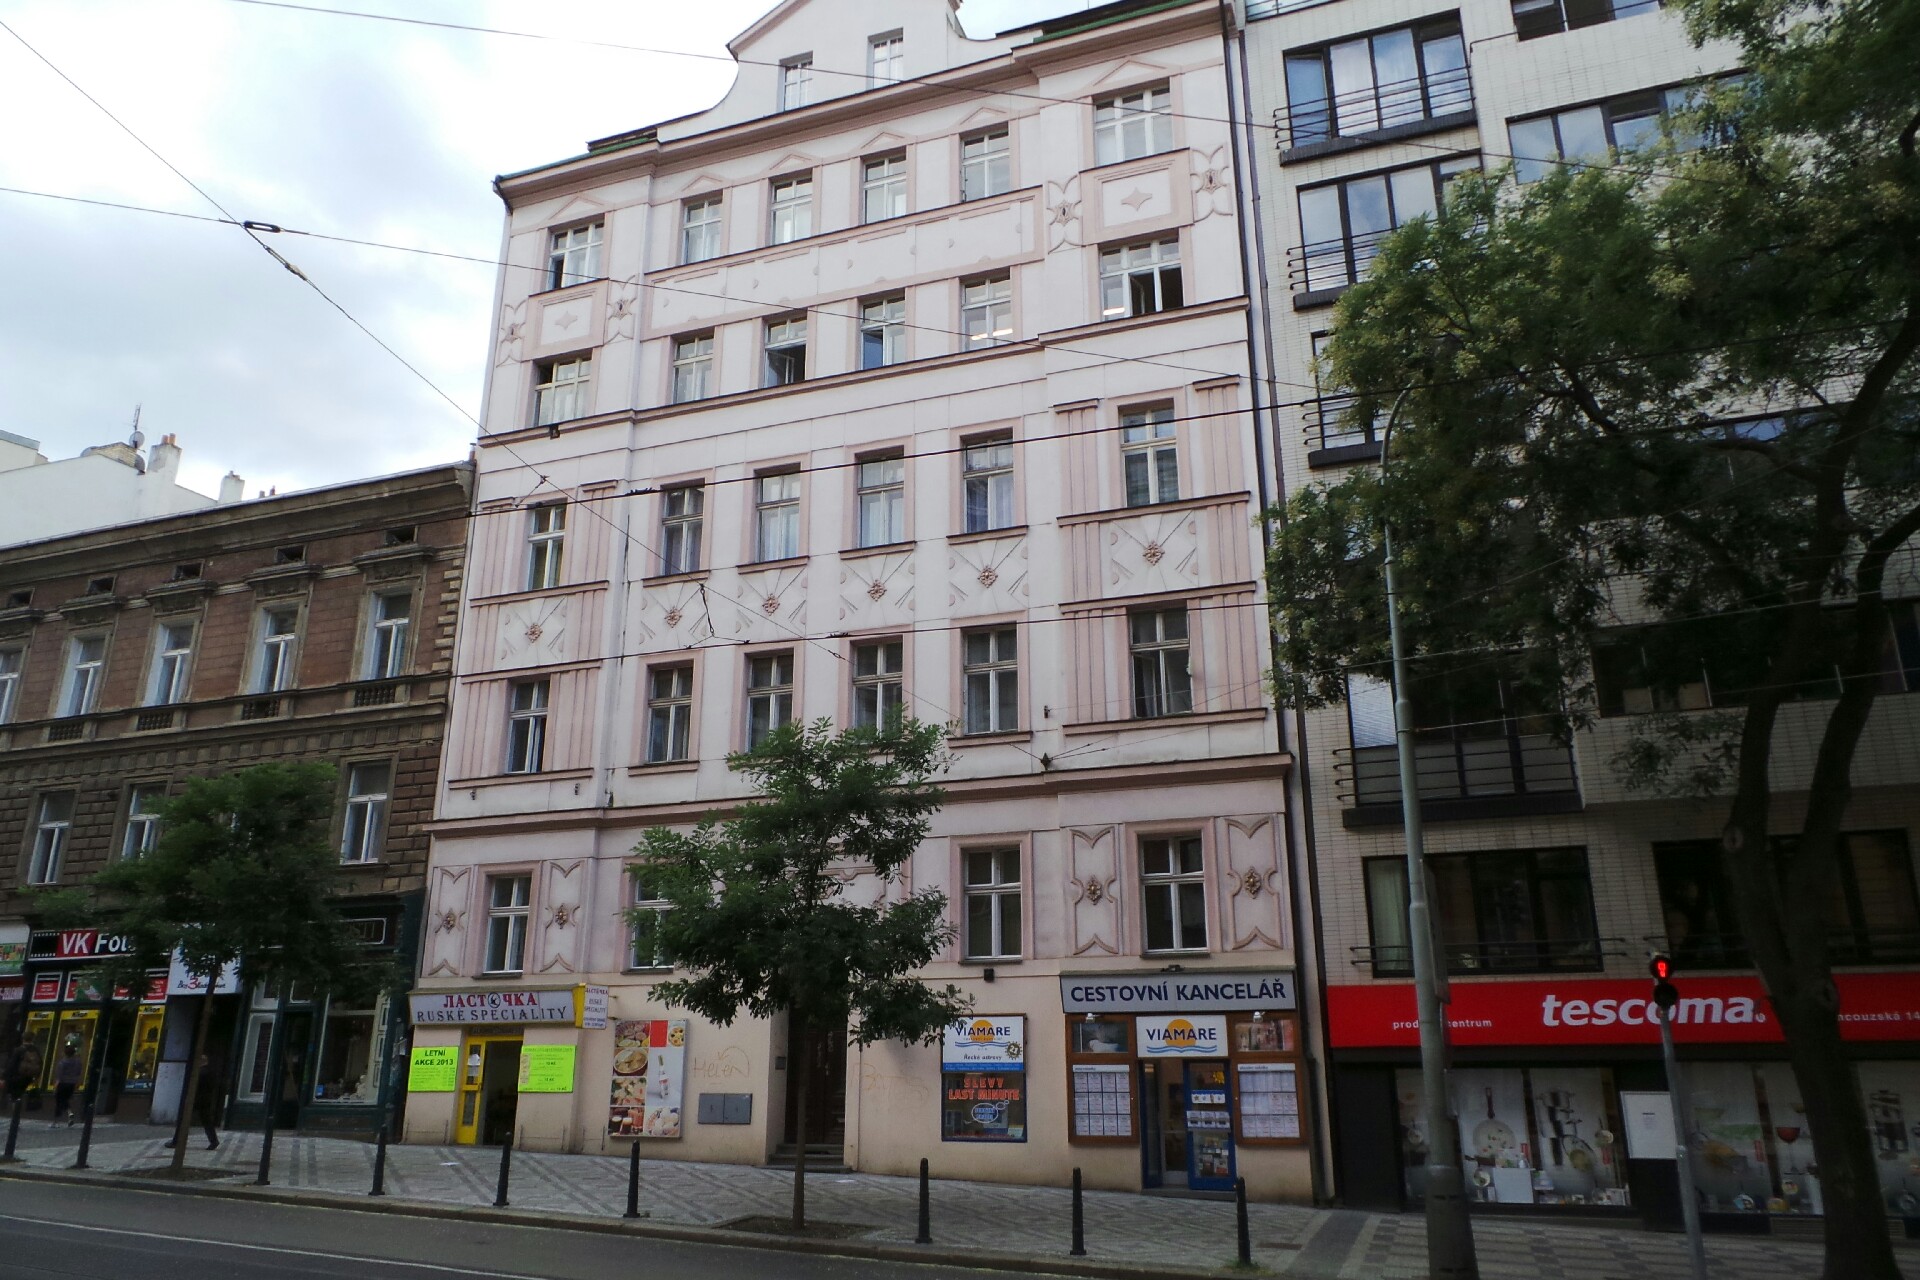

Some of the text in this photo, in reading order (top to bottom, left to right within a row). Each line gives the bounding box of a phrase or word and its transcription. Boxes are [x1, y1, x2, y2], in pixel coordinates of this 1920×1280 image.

[62, 932, 137, 955] VK Fot
[1071, 978, 1287, 1002] CESTOVNÍ KANCELÁŘ
[417, 1006, 567, 1022] RUSKÉ SPECIALITY
[1542, 994, 1754, 1026] tescoma
[955, 1026, 1011, 1036] VIAMARE
[1146, 1028, 1217, 1041] VIAMARE
[424, 1049, 446, 1057] LETNÍ
[437, 1058, 454, 1066] 2013
[963, 1077, 1005, 1089] SLEVY
[948, 1088, 1020, 1101] LAST MINUTE
